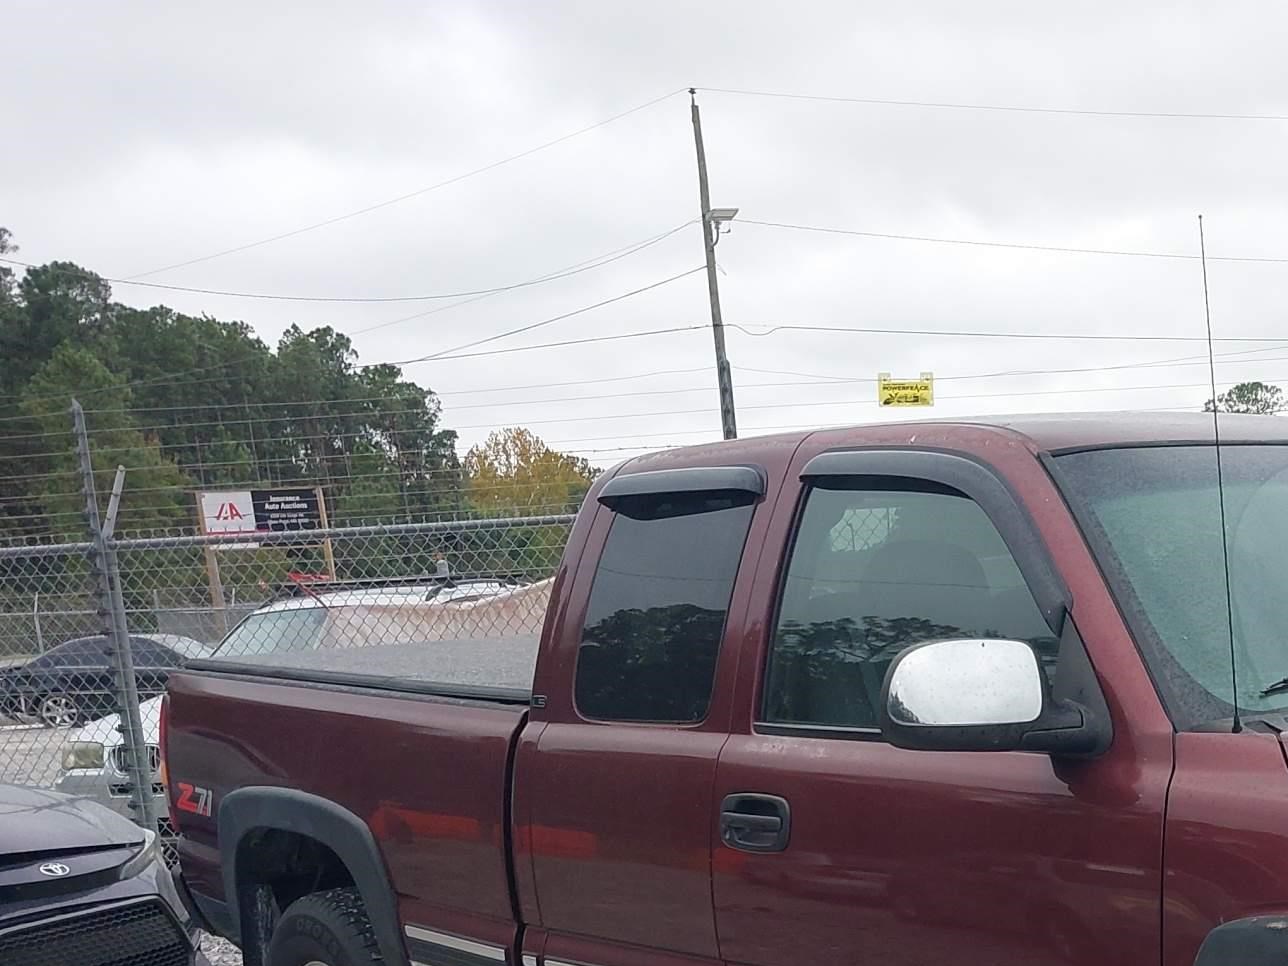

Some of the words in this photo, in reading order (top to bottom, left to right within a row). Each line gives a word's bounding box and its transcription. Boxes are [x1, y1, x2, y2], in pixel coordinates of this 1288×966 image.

[264, 502, 280, 510] Auto
[281, 502, 308, 510] Auctions
[176, 782, 213, 817] Z71
